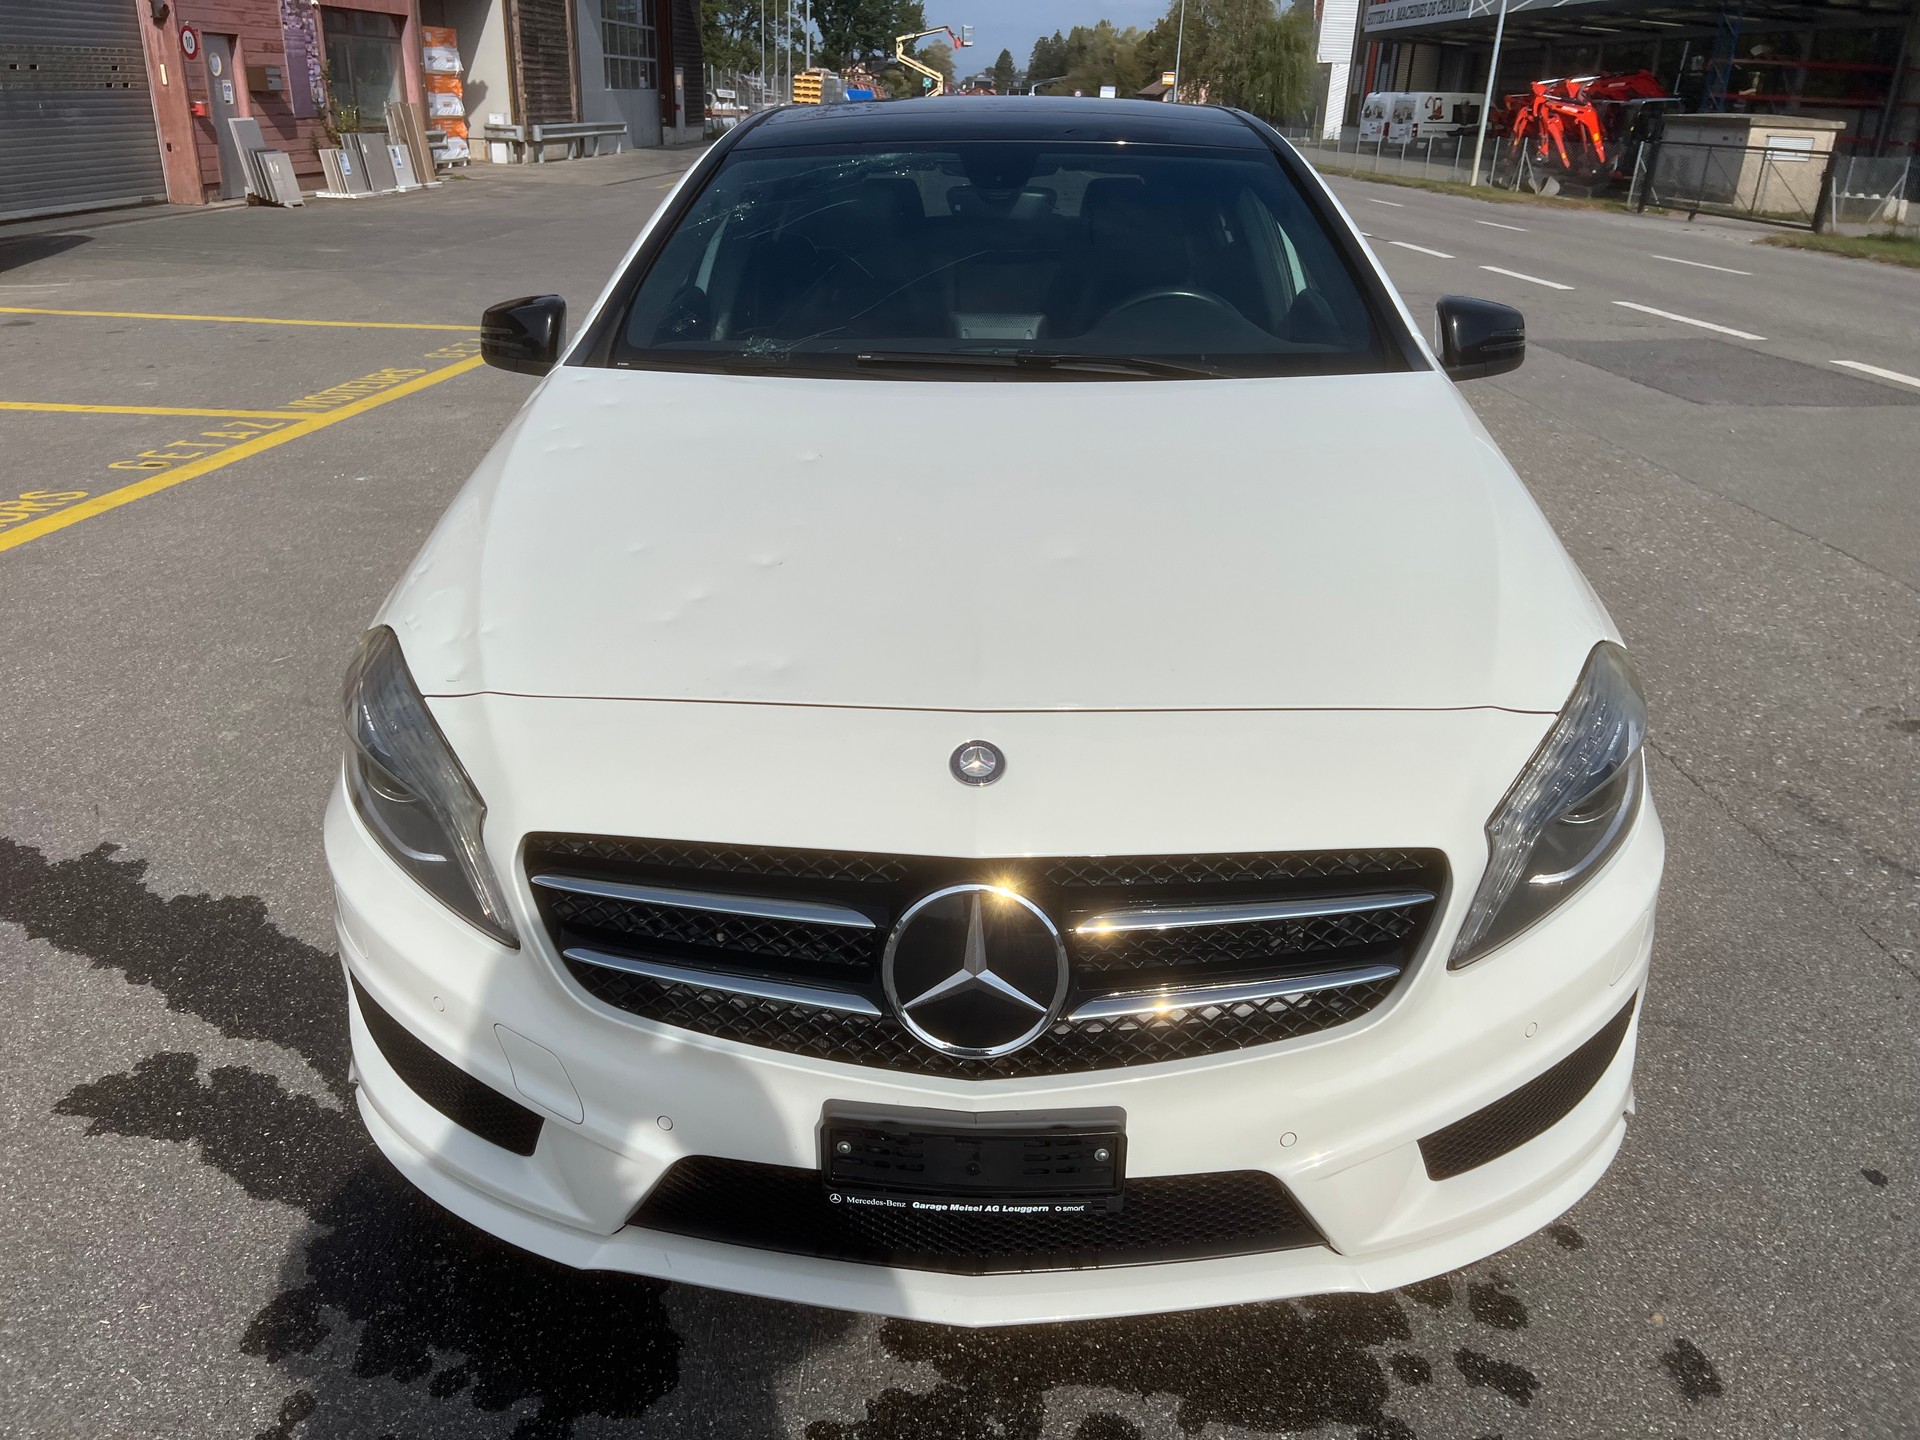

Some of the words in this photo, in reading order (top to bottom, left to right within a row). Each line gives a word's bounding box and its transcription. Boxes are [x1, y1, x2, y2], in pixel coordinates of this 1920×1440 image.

[1396, 3, 1426, 21] MACHINES
[1426, 1, 1437, 17] DE
[185, 36, 193, 49] 10
[276, 367, 426, 408] VISITEURS
[108, 421, 285, 470] GETAZ
[846, 1196, 907, 1208] Mercedes-Benz
[912, 1201, 948, 1212] Garage
[1002, 1204, 1049, 1214] Leuggern
[1062, 1204, 1085, 1212] smart
